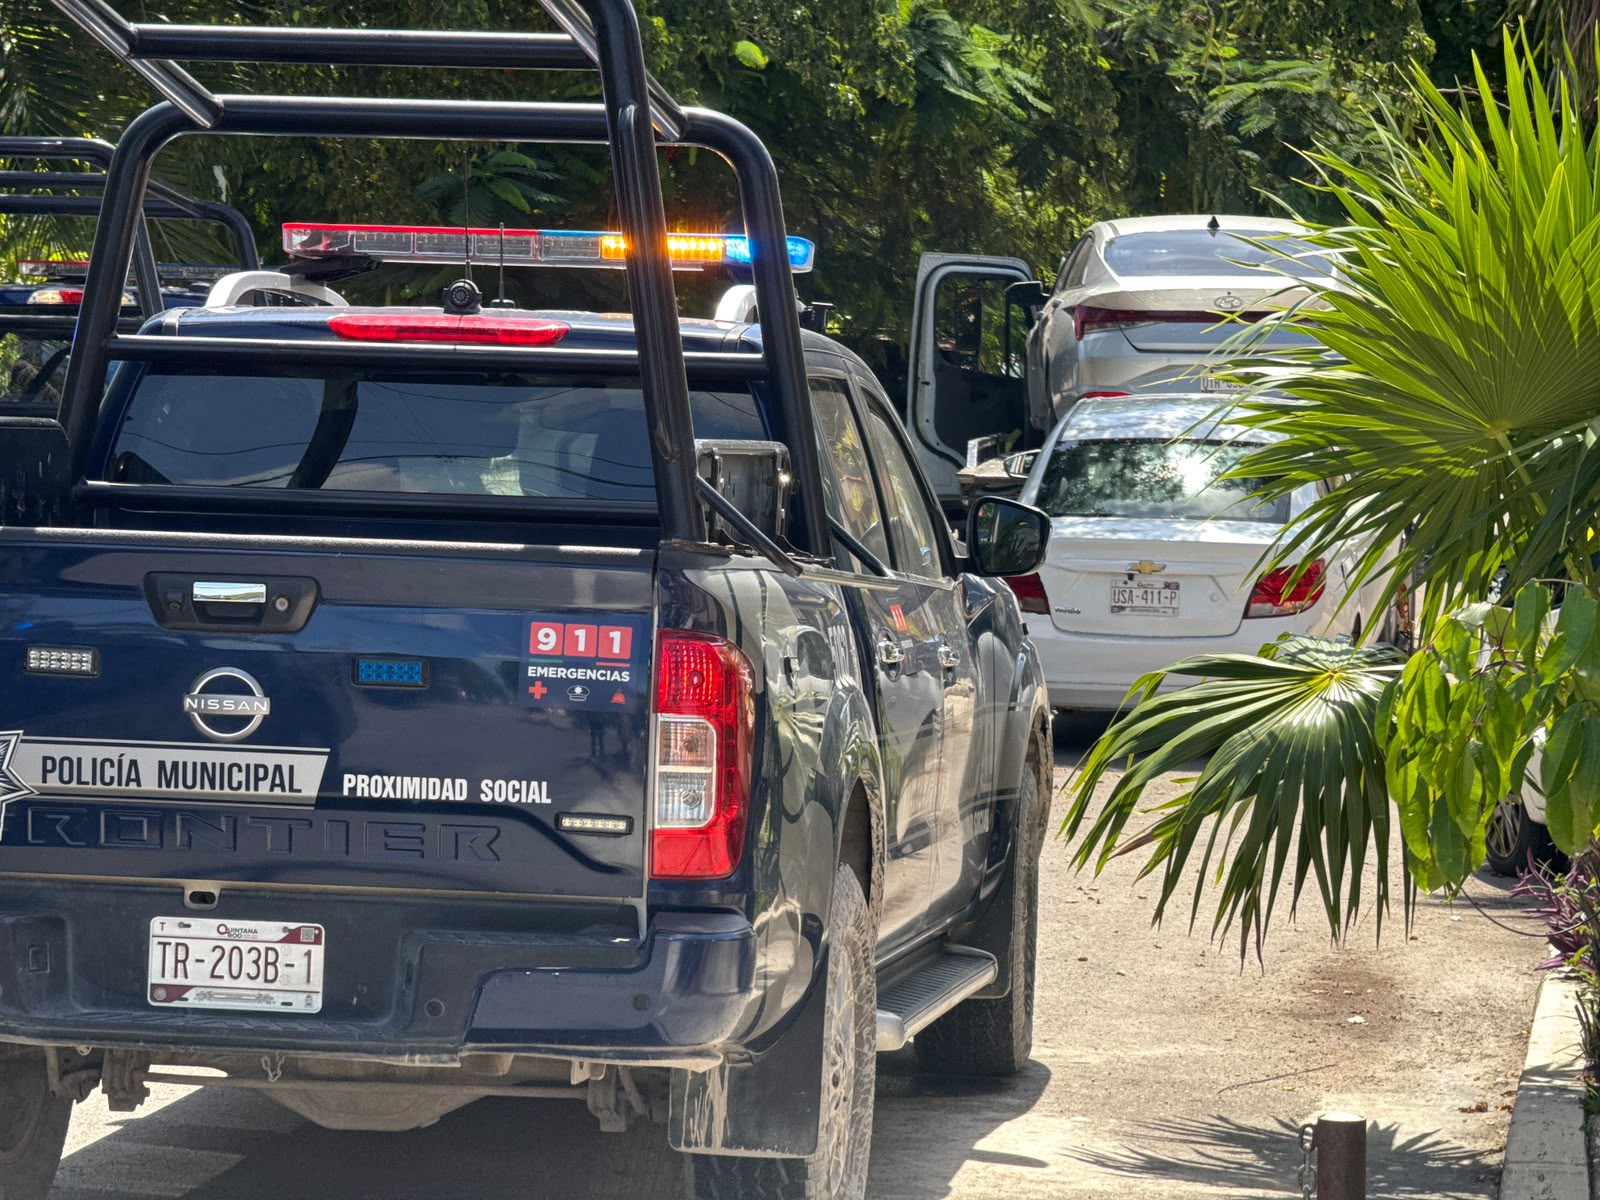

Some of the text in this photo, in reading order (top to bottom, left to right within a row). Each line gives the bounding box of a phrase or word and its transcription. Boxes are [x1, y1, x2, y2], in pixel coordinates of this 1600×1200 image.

[1112, 588, 1178, 606] USA-411-P
[527, 666, 631, 682] EMERGENCIAS
[185, 697, 268, 712] NISSAN
[41, 753, 303, 793] POLICÍA MUNICIPAL
[342, 773, 552, 804] PROXIMIDAD SOCIAL
[4, 804, 501, 862] RONTIER
[159, 921, 167, 931] T
[216, 923, 259, 936] QUINTANA
[157, 941, 313, 984] TR-203B-1
